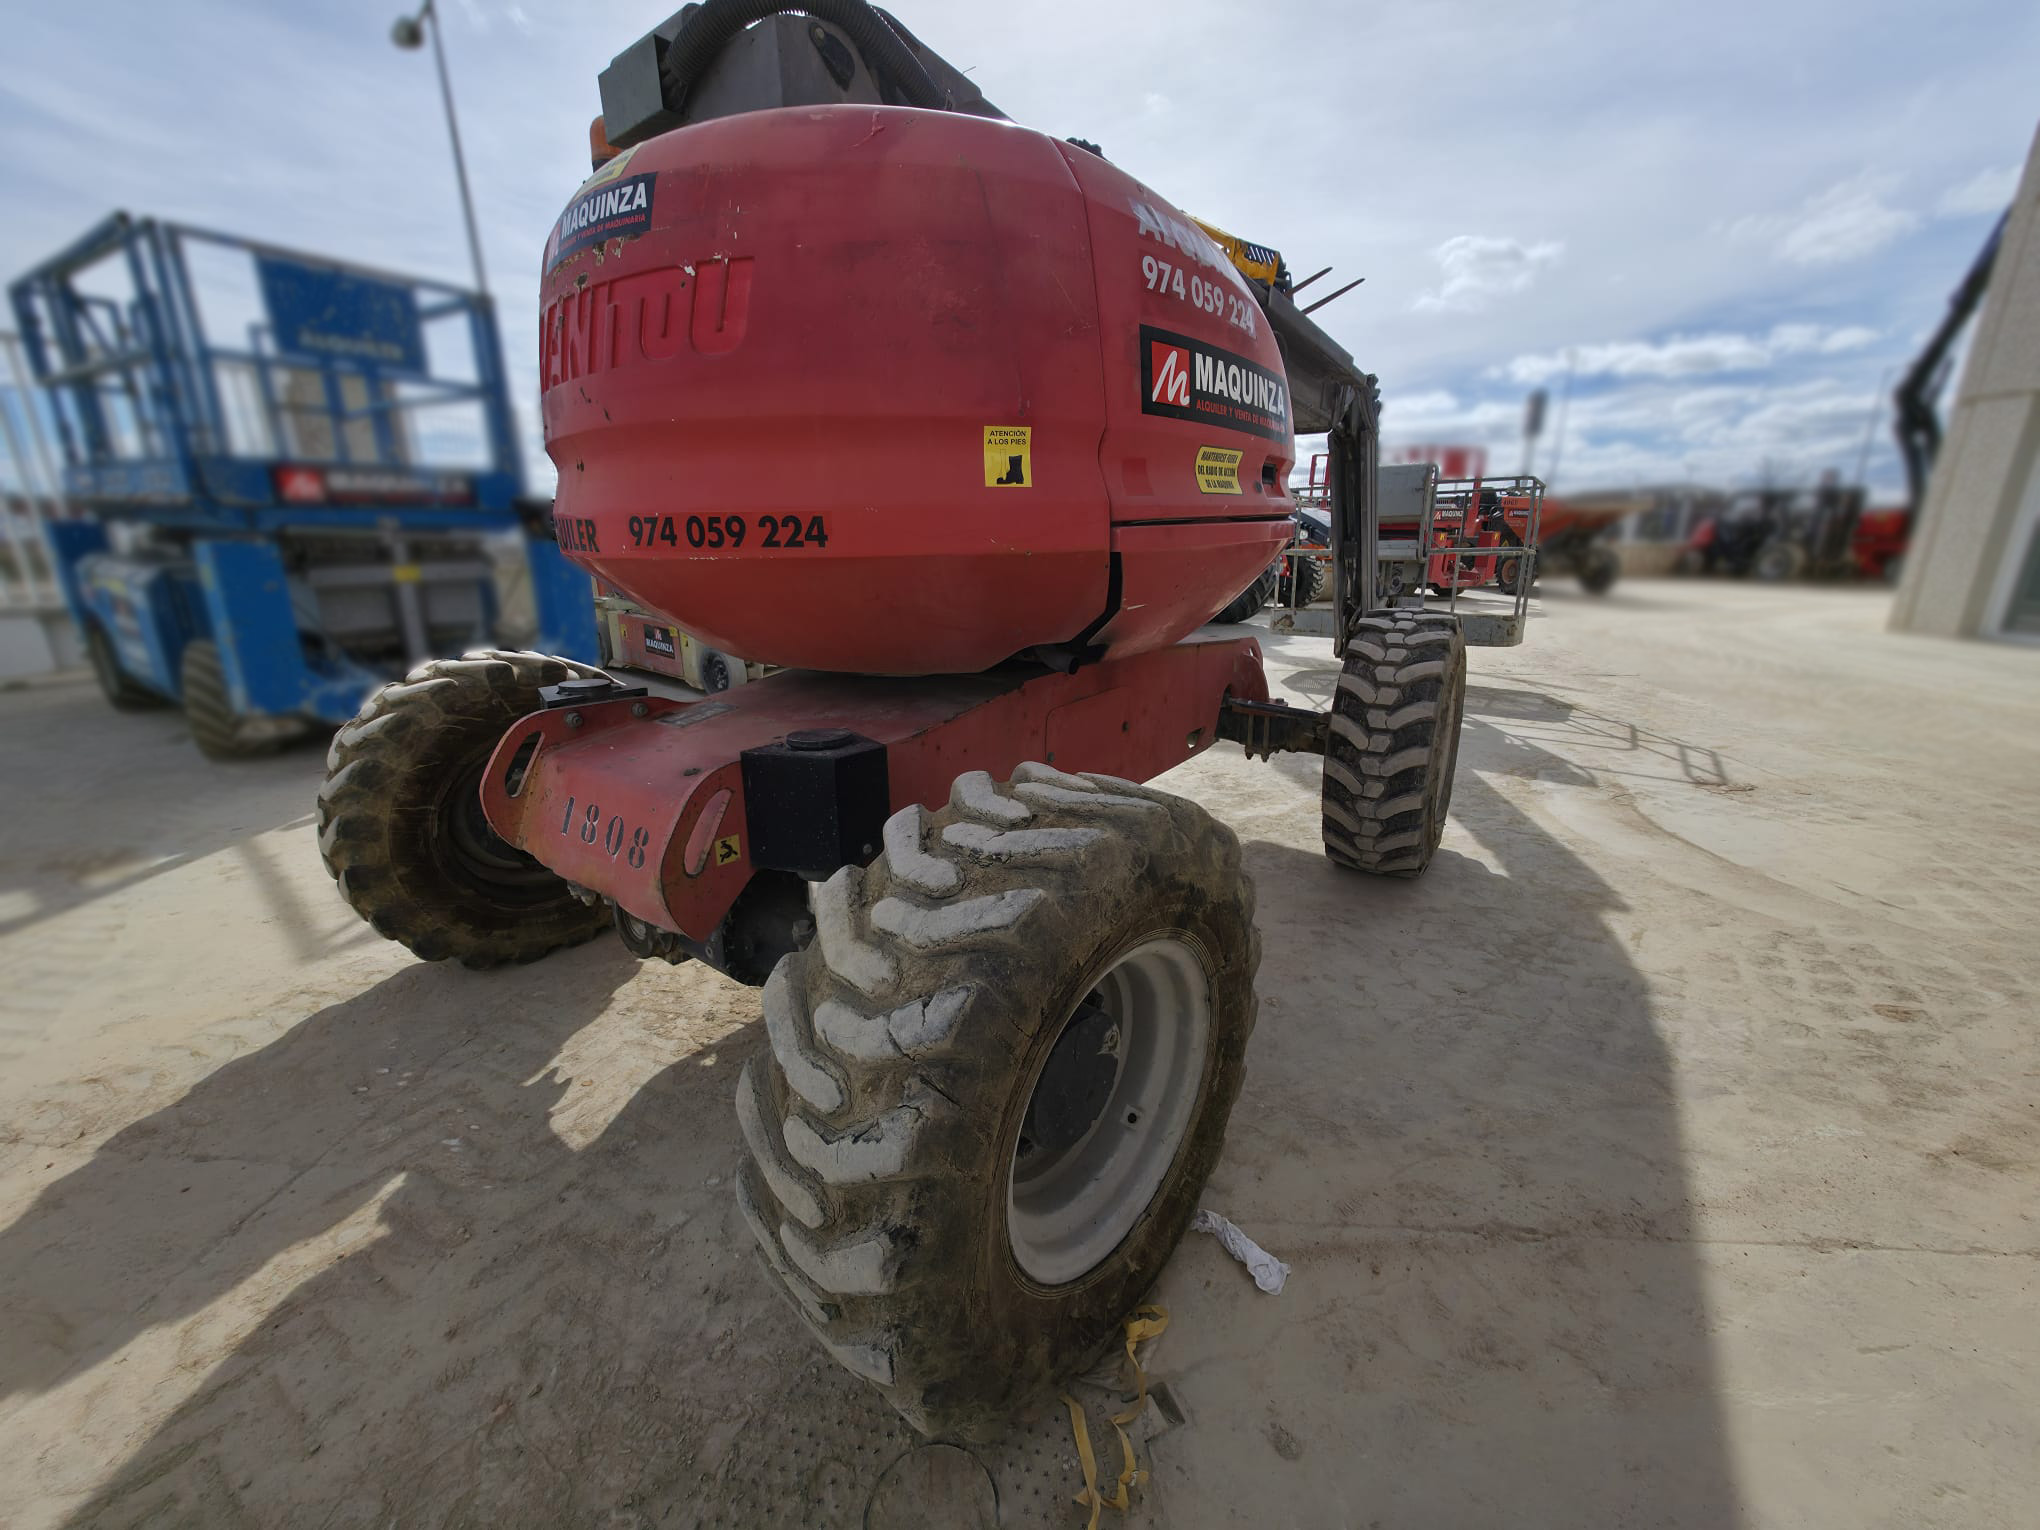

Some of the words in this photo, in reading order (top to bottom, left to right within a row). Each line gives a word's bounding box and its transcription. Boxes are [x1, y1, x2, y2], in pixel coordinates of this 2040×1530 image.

[561, 182, 647, 240] MAQUINZA
[1142, 255, 1186, 300] 974
[1191, 276, 1223, 316] 059
[1229, 295, 1257, 339] 224
[1195, 352, 1285, 417] MAQUINZA
[1196, 400, 1227, 416] ALQUILER
[629, 515, 678, 547] 974
[686, 515, 747, 548] 059
[758, 515, 829, 548] 224
[560, 796, 649, 869] 1808
